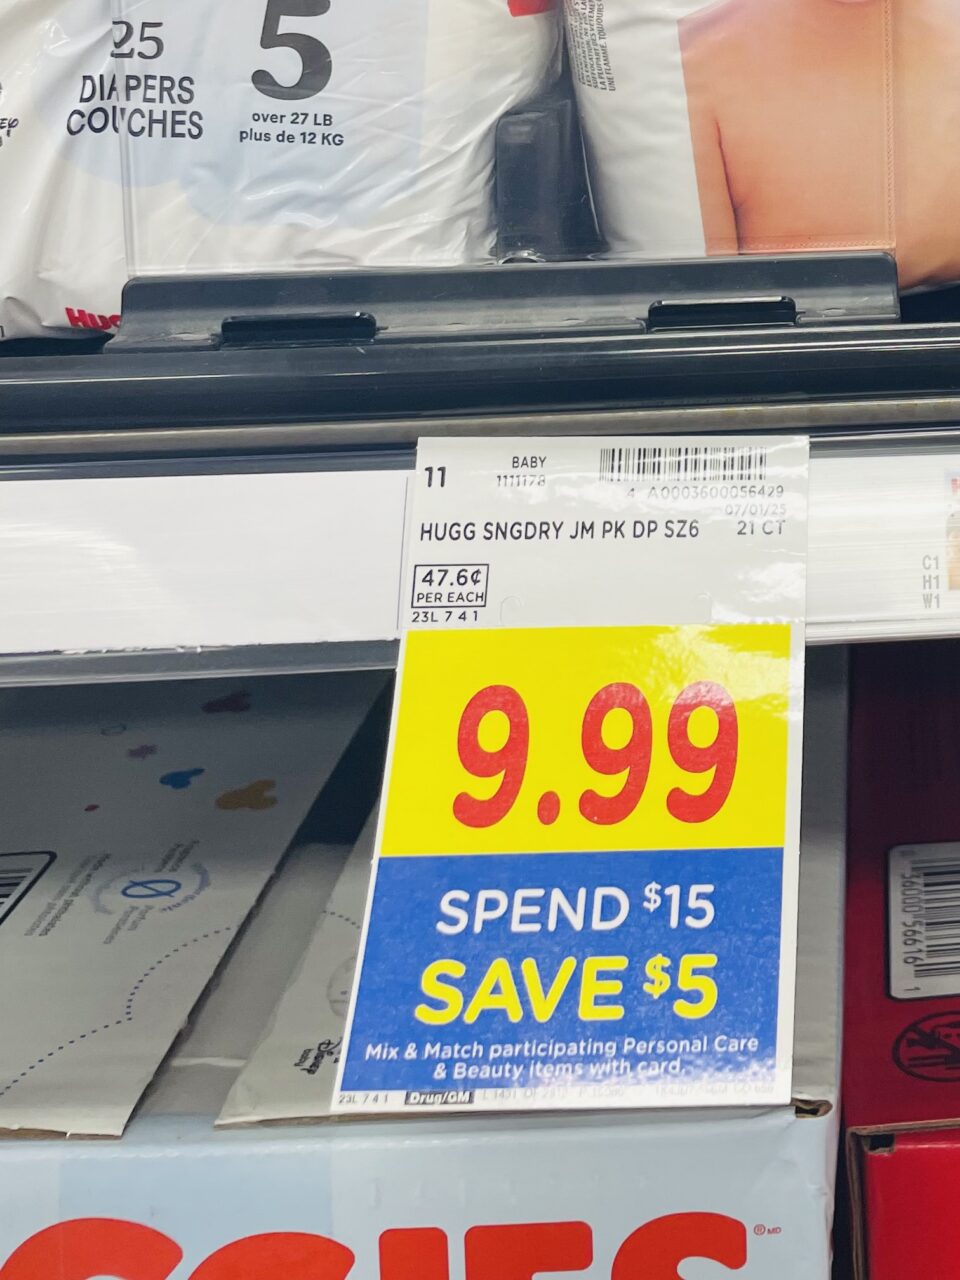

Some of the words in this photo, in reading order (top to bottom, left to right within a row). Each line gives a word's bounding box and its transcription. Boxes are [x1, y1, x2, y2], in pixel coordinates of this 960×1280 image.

[596, 3, 608, 40] TOUJOURS
[110, 20, 164, 60] 25
[252, 112, 287, 126] over
[290, 112, 310, 126] 27
[313, 113, 334, 128] LB
[239, 128, 271, 147] plus
[275, 130, 297, 144] de
[299, 131, 318, 145] 12
[321, 132, 345, 146] KG
[424, 466, 446, 488] 11
[512, 456, 547, 469] BABY
[419, 521, 476, 541] HUGG
[483, 520, 565, 541] SNGDRY
[569, 520, 595, 540] JM
[602, 519, 626, 539] PK
[633, 520, 658, 539] DP
[664, 519, 699, 539] SZ6
[737, 520, 756, 536] 21
[761, 519, 786, 536] CT
[421, 568, 483, 587] 47.6¢
[417, 591, 442, 604] PER
[447, 591, 485, 603] EACH
[412, 610, 438, 623] 23L
[452, 680, 739, 829] 9.99
[436, 885, 630, 936] SPEND
[643, 881, 716, 930] $15
[414, 955, 630, 1026] SAVE
[643, 952, 719, 1020] $5
[365, 1042, 398, 1061] Mix
[404, 1042, 418, 1060] &
[423, 1039, 485, 1060] Match
[489, 1037, 618, 1062] participating
[623, 1034, 708, 1054] Personal
[714, 1034, 759, 1053] Care
[433, 1062, 447, 1081] &
[454, 1059, 524, 1083] Beauty
[529, 1058, 583, 1079] items
[589, 1057, 632, 1077] with
